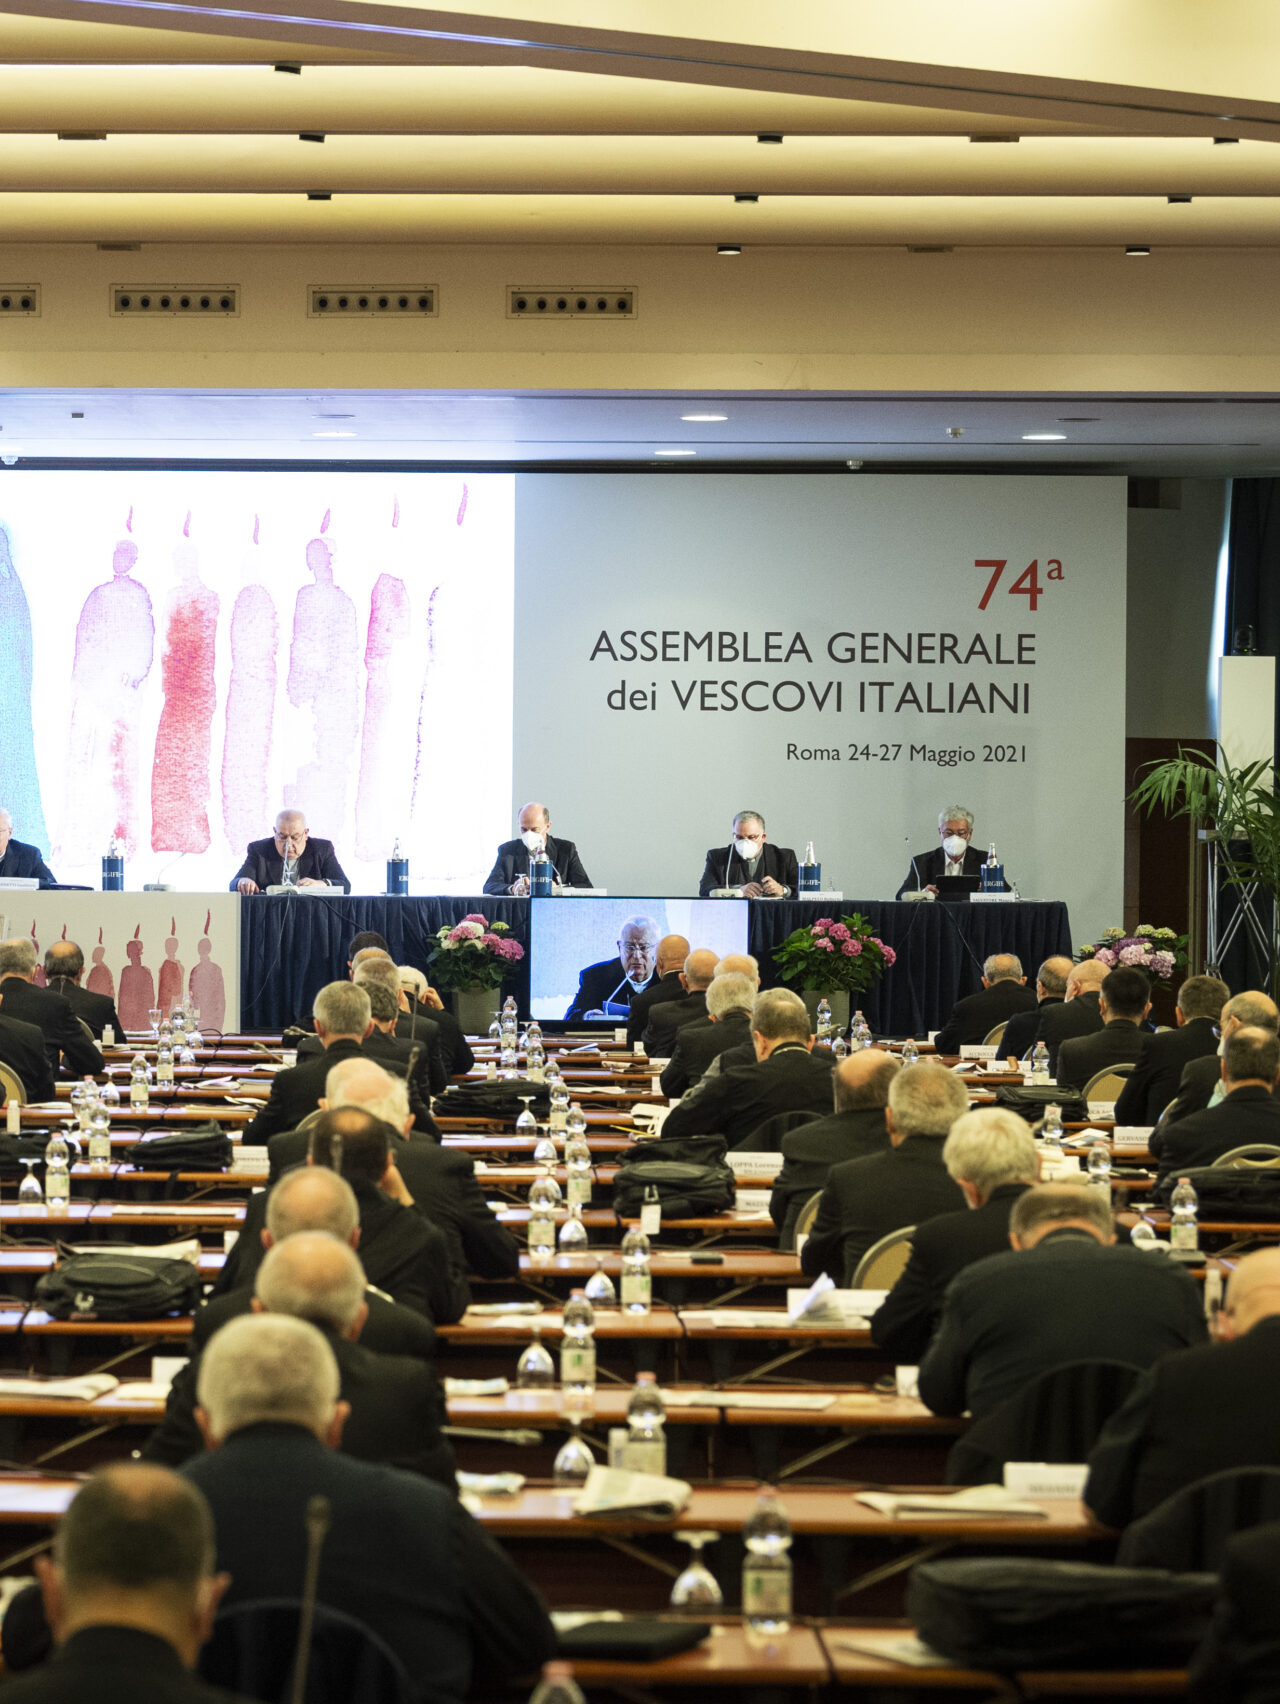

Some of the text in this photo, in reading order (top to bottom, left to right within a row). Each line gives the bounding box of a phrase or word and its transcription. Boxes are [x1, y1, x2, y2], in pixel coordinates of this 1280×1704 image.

[590, 630, 1036, 665] ASSEMBLEA GENERALE
[606, 679, 1030, 714] dei VESCOVI ITALIANI
[787, 743, 1026, 767] Roma 24-27 Maggio 2021
